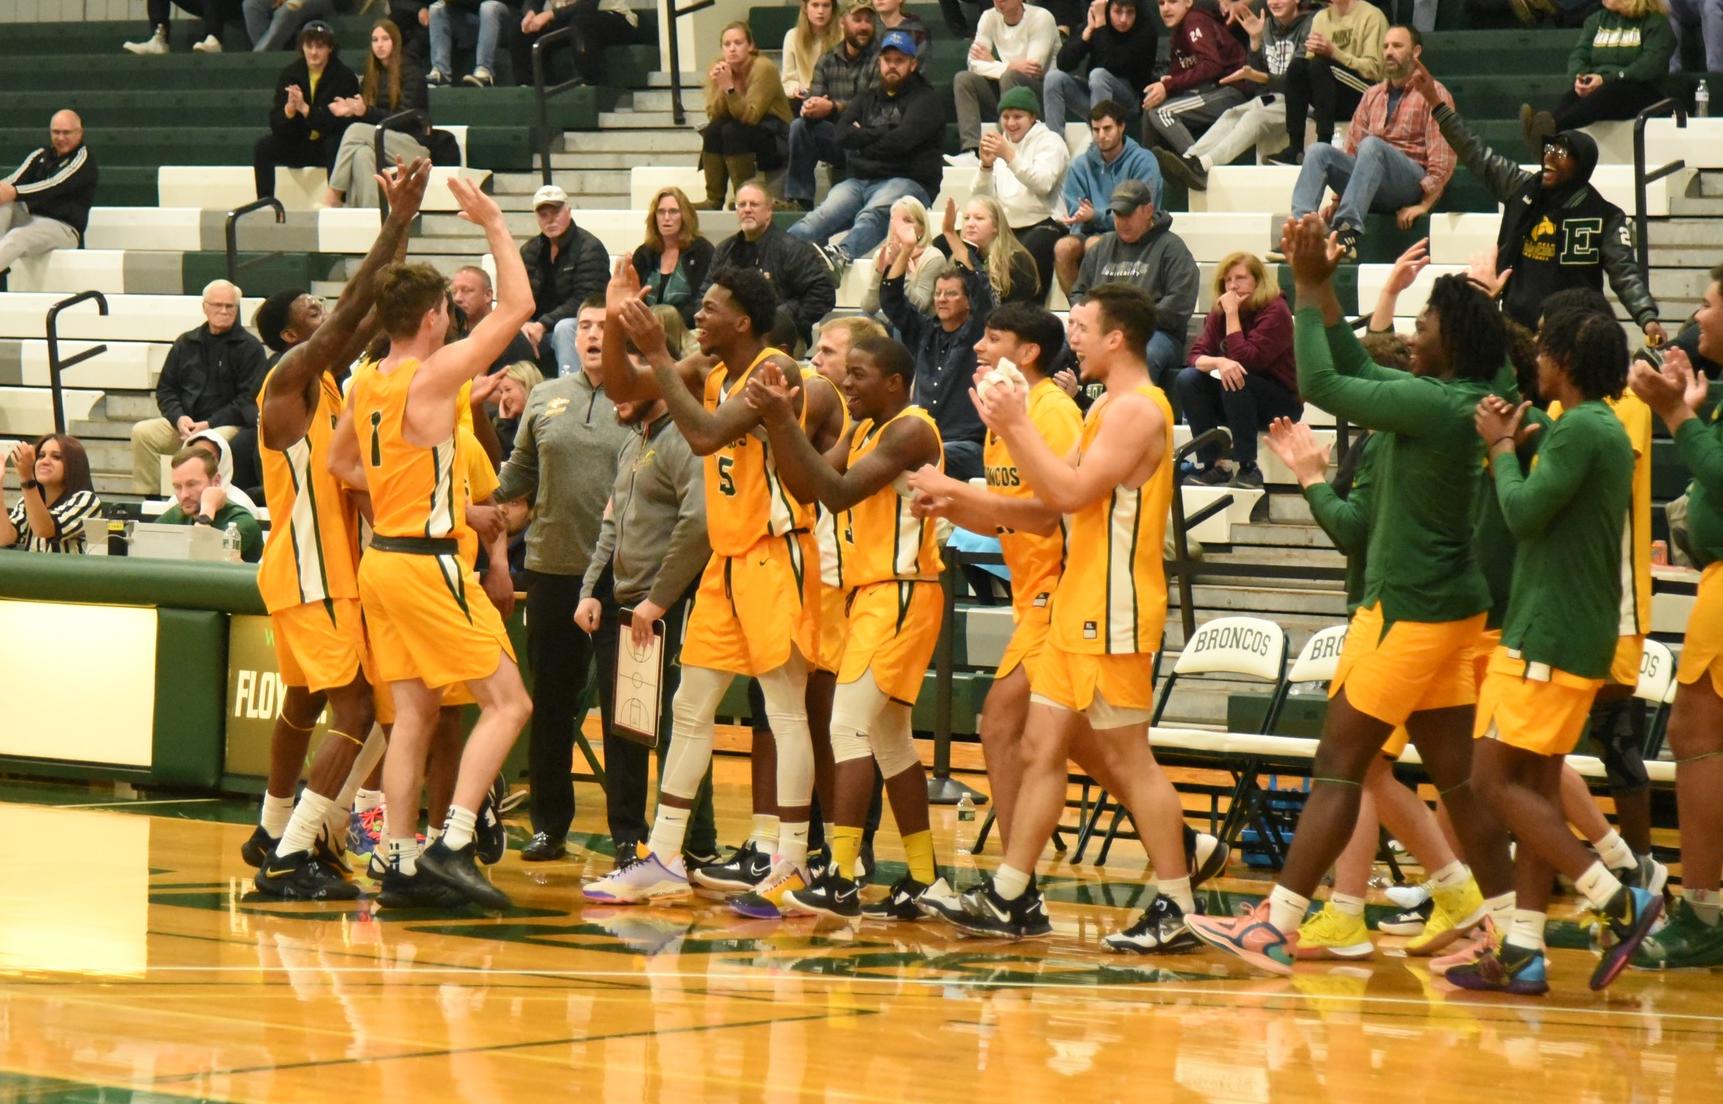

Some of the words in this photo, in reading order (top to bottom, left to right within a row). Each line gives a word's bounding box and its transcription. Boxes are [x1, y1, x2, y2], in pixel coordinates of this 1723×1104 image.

[1560, 218, 1603, 265] E
[370, 410, 382, 468] 1
[717, 455, 736, 497] 5
[1194, 627, 1271, 656] BRONCOS
